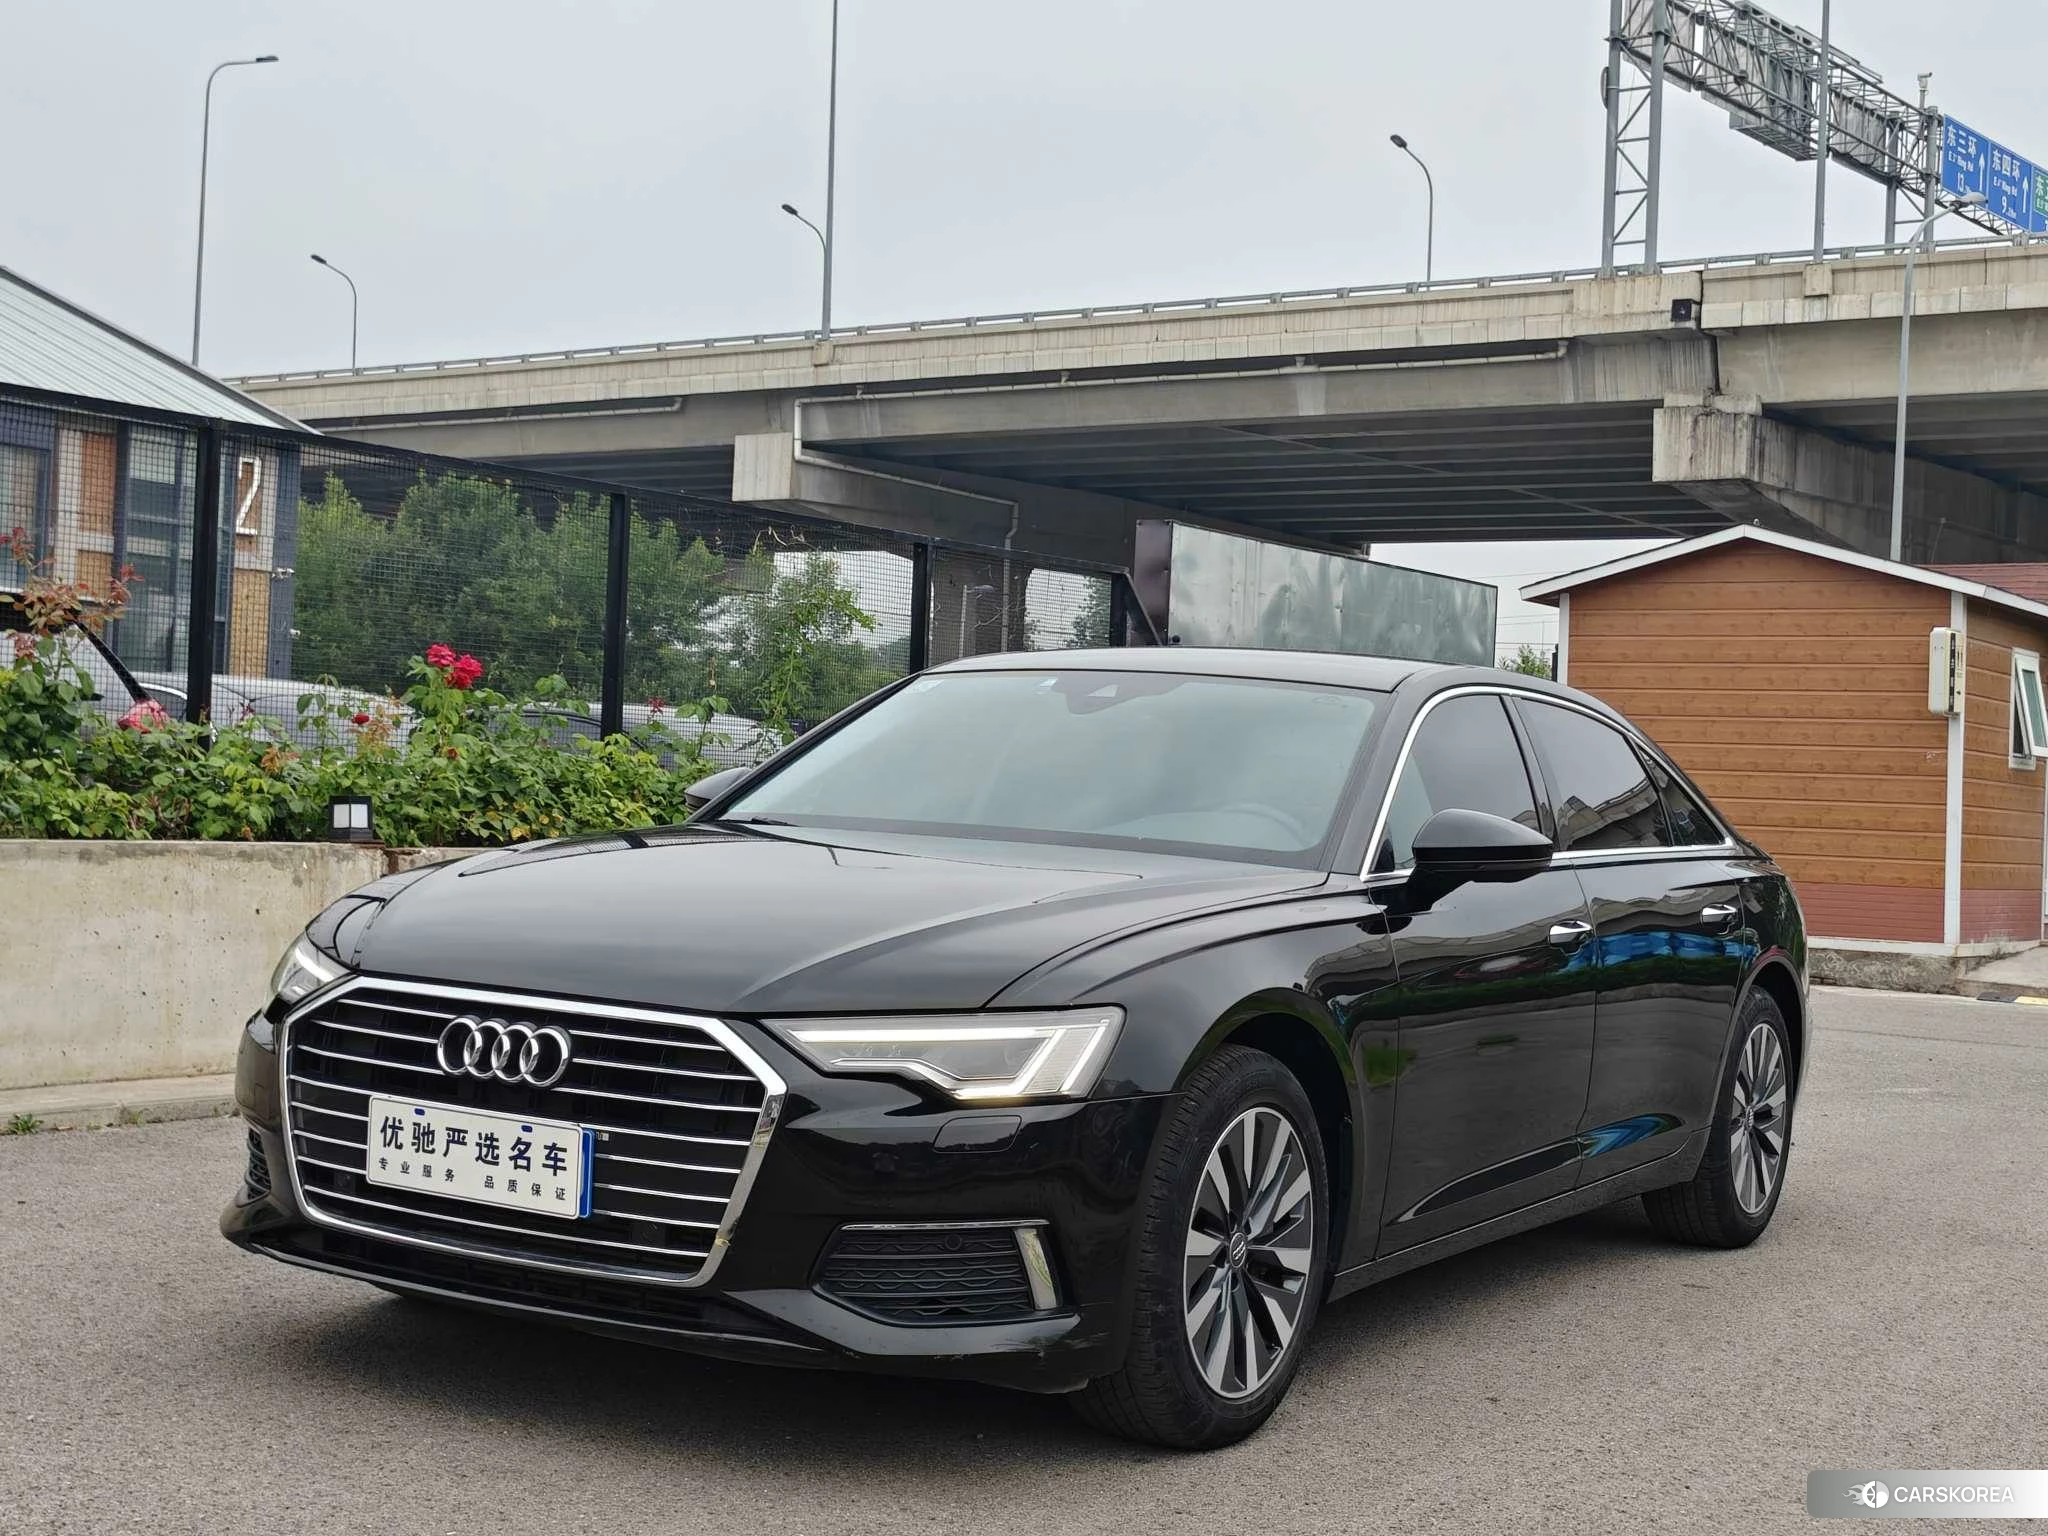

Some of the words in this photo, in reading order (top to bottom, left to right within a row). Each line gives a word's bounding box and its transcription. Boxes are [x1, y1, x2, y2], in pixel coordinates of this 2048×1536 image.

[1947, 125, 1976, 158] 东三环
[1992, 149, 2020, 182] 东四环
[236, 456, 261, 535] 2
[380, 1115, 568, 1177] 优驰严选名车
[378, 1157, 455, 1183] 专业服务
[484, 1175, 566, 1201] 品质保证
